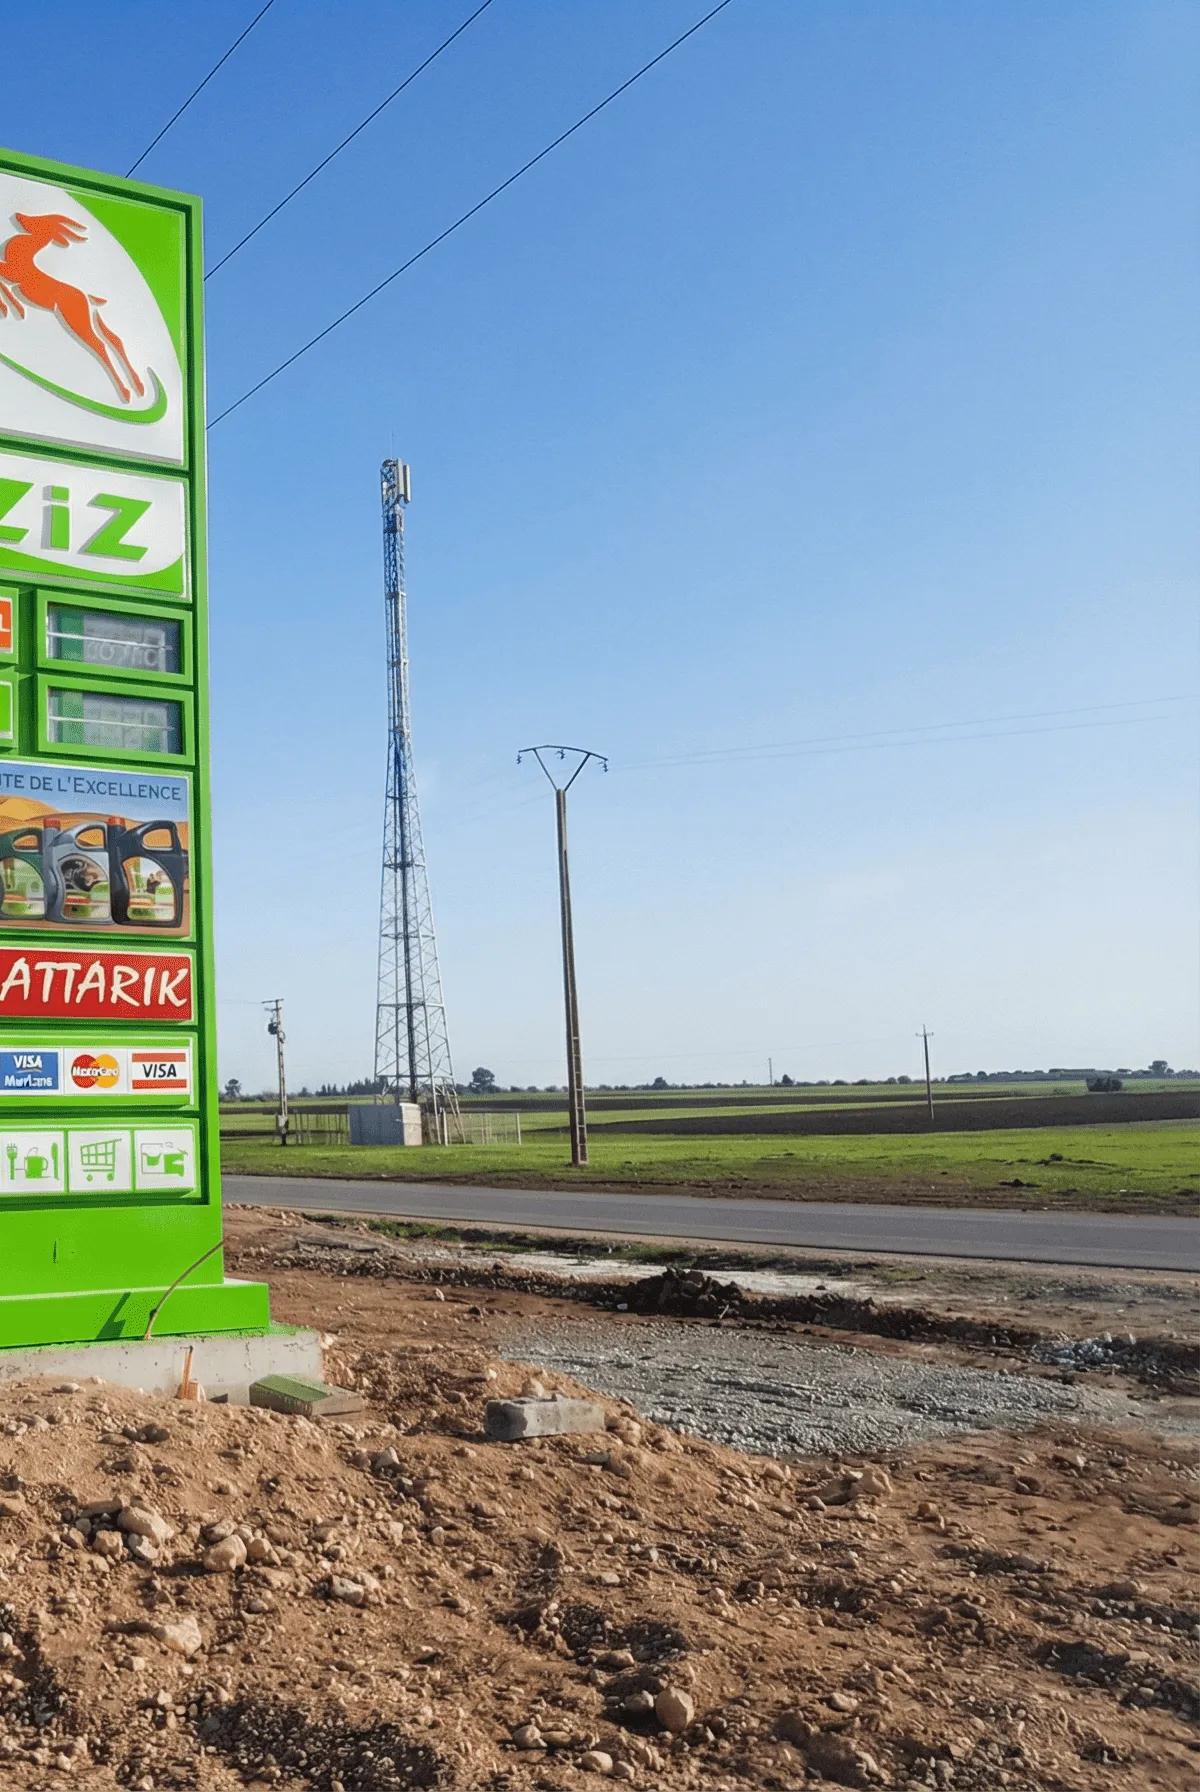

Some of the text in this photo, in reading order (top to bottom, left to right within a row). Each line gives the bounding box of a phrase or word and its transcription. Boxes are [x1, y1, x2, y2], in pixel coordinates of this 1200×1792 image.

[29, 775, 53, 791] DE
[0, 957, 189, 1007] ATTARIK
[12, 1055, 43, 1069] VISA
[142, 1063, 178, 1078] VISA
